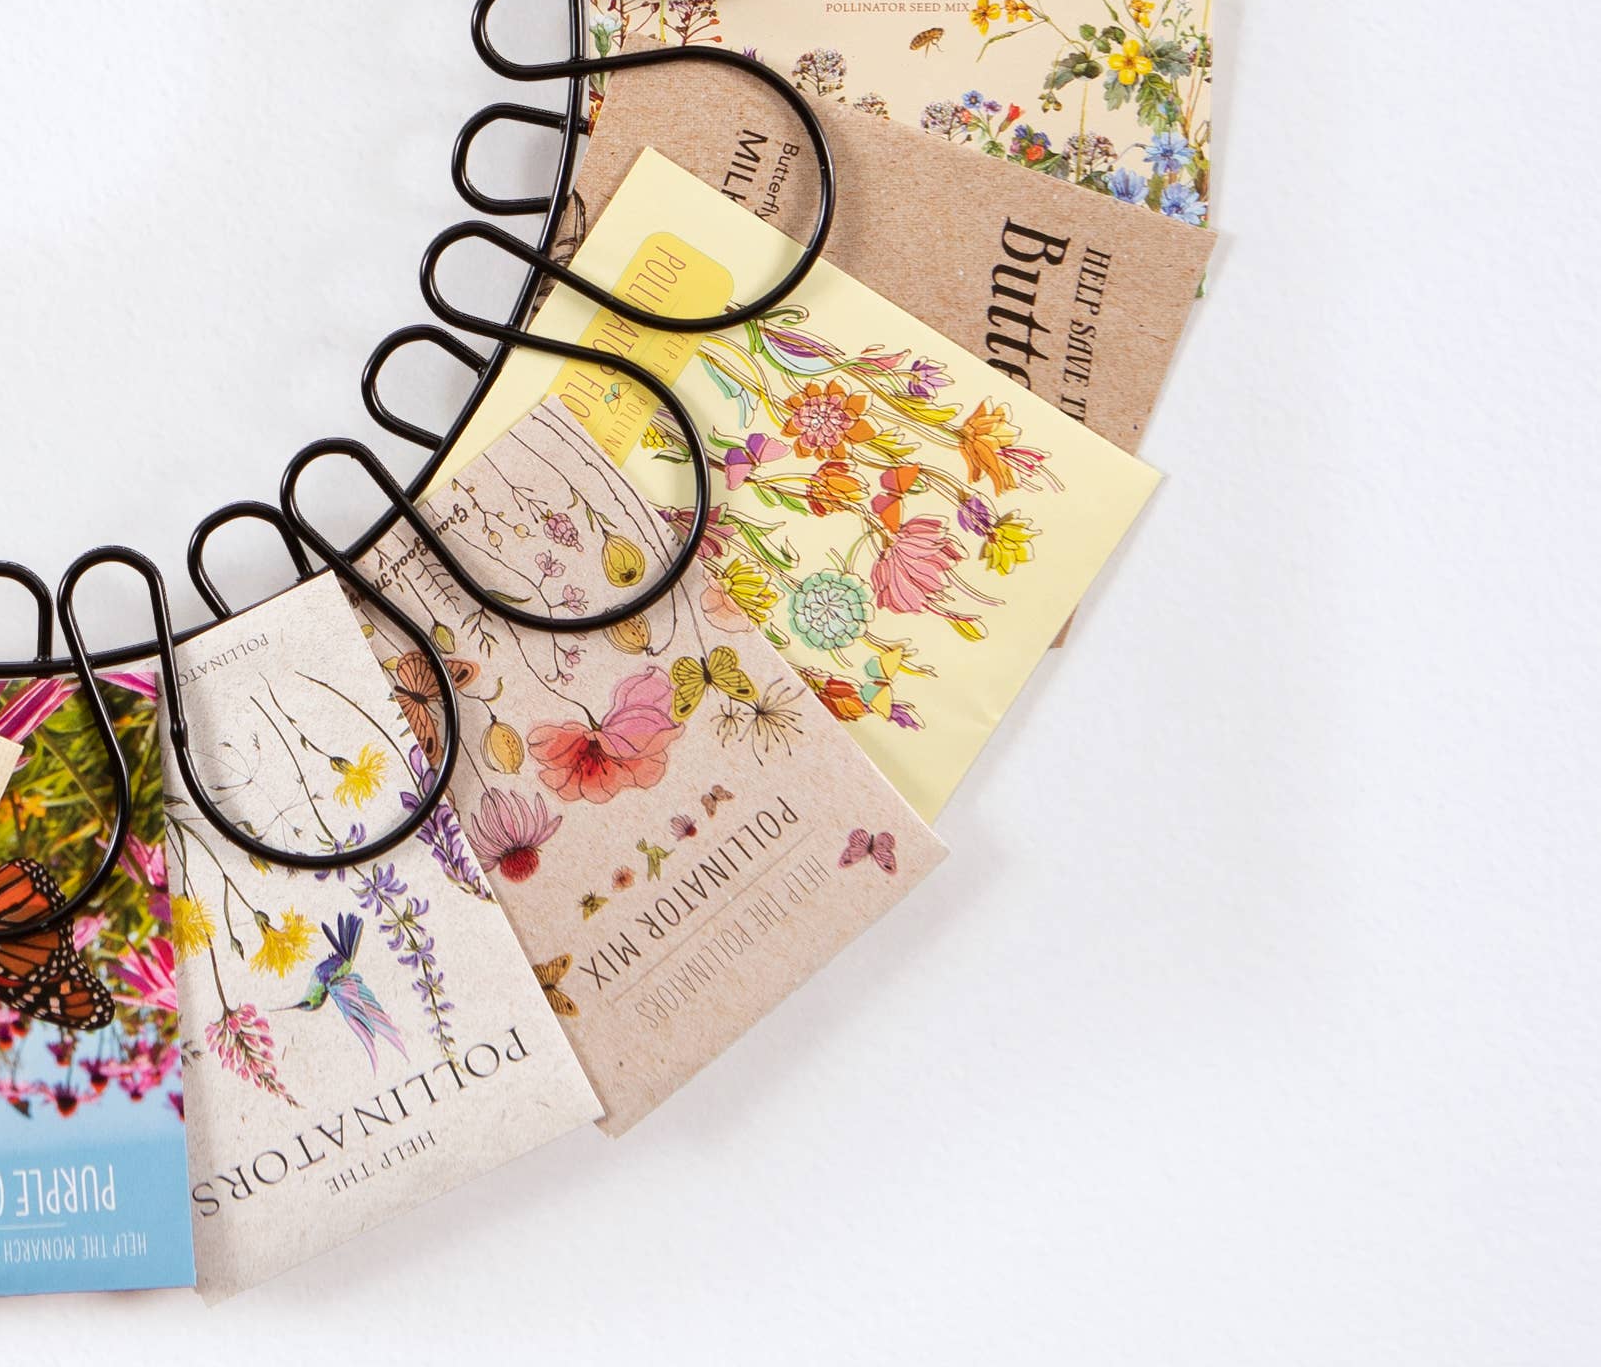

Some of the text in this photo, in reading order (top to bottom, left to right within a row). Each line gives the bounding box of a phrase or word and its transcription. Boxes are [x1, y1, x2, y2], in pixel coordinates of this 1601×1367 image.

[825, 1, 970, 14] POLLINATOR SEED MIX
[1075, 246, 1112, 316] HELP
[1063, 319, 1097, 388] SAVE
[578, 796, 799, 991] POLLINATOR MIX
[634, 855, 831, 1029] HELP THE POLLINATORS
[192, 1027, 532, 1218] POLLINATORS
[13, 1164, 117, 1217] PURPLE
[325, 1131, 438, 1196] HELP THE
[3, 1236, 76, 1264] MONARCH
[82, 1234, 108, 1260] THE
[112, 1231, 147, 1258] HELP
